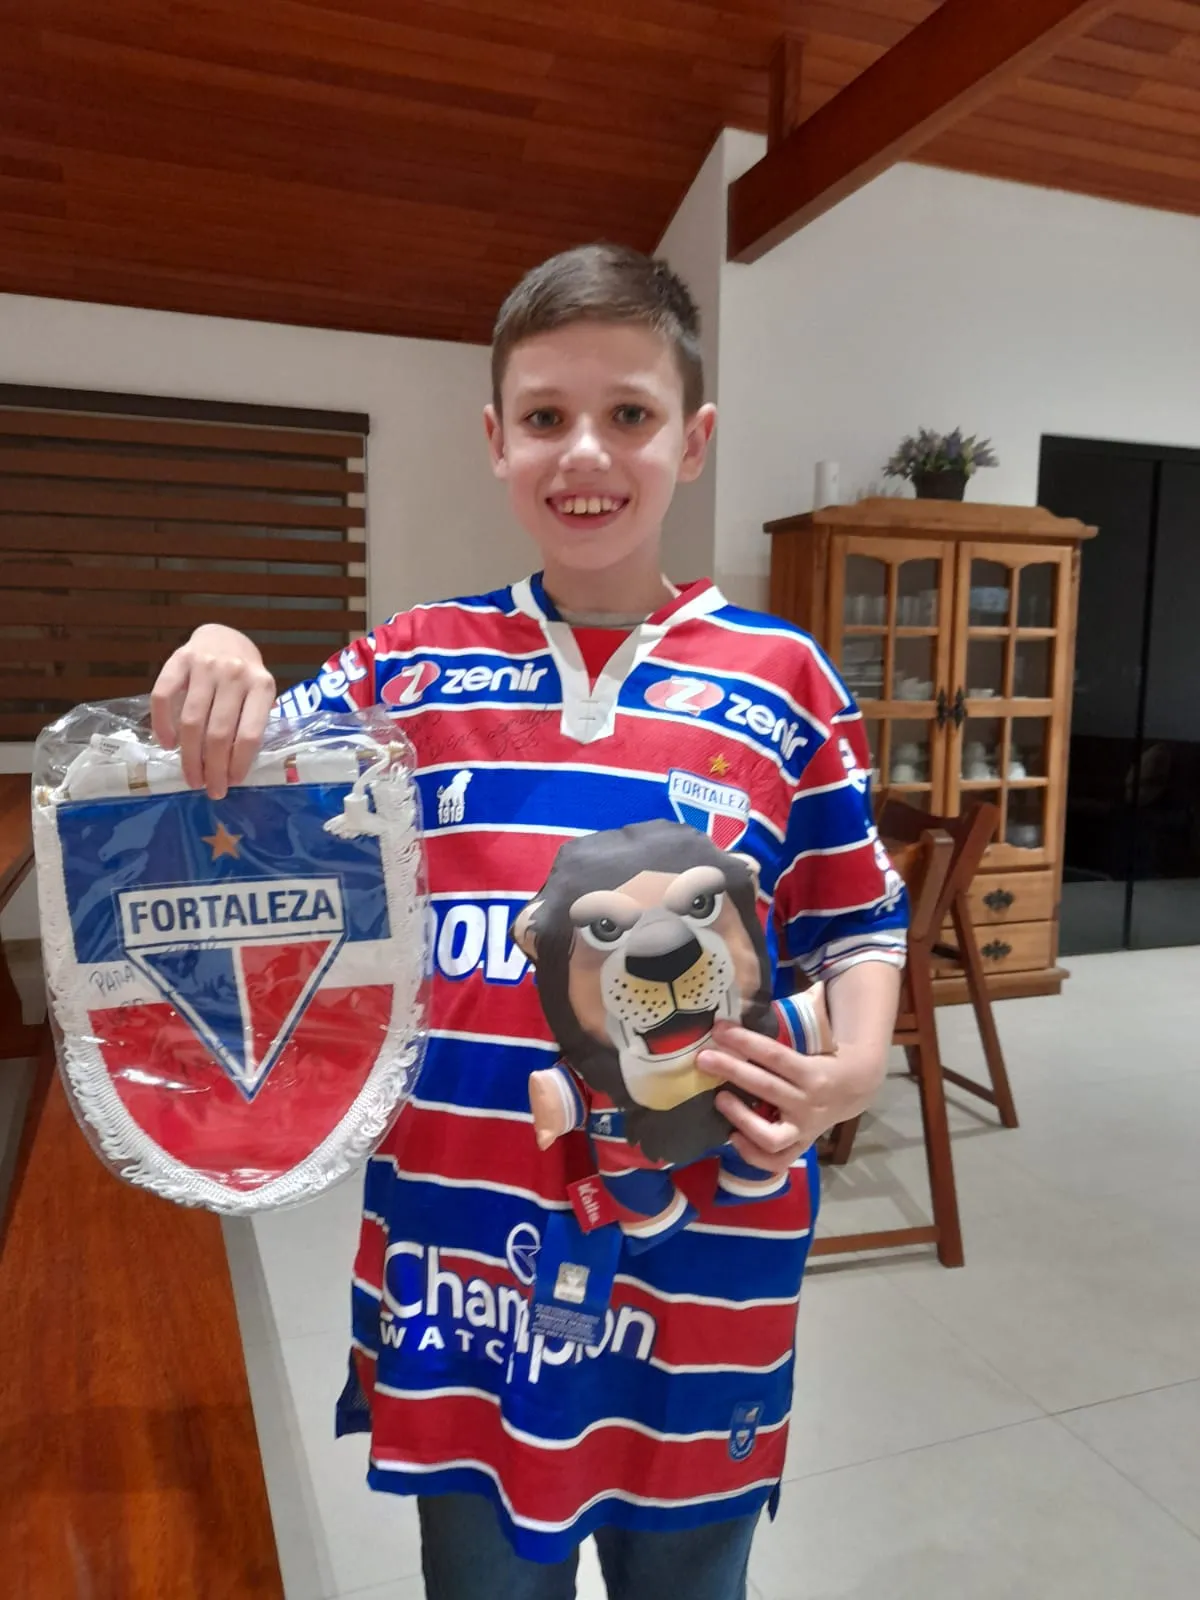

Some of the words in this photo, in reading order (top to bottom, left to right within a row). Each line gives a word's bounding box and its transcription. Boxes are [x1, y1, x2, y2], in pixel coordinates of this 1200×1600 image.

[440, 662, 548, 694] zenir
[438, 806, 465, 825] 1918
[128, 888, 337, 935] FORTALEZA
